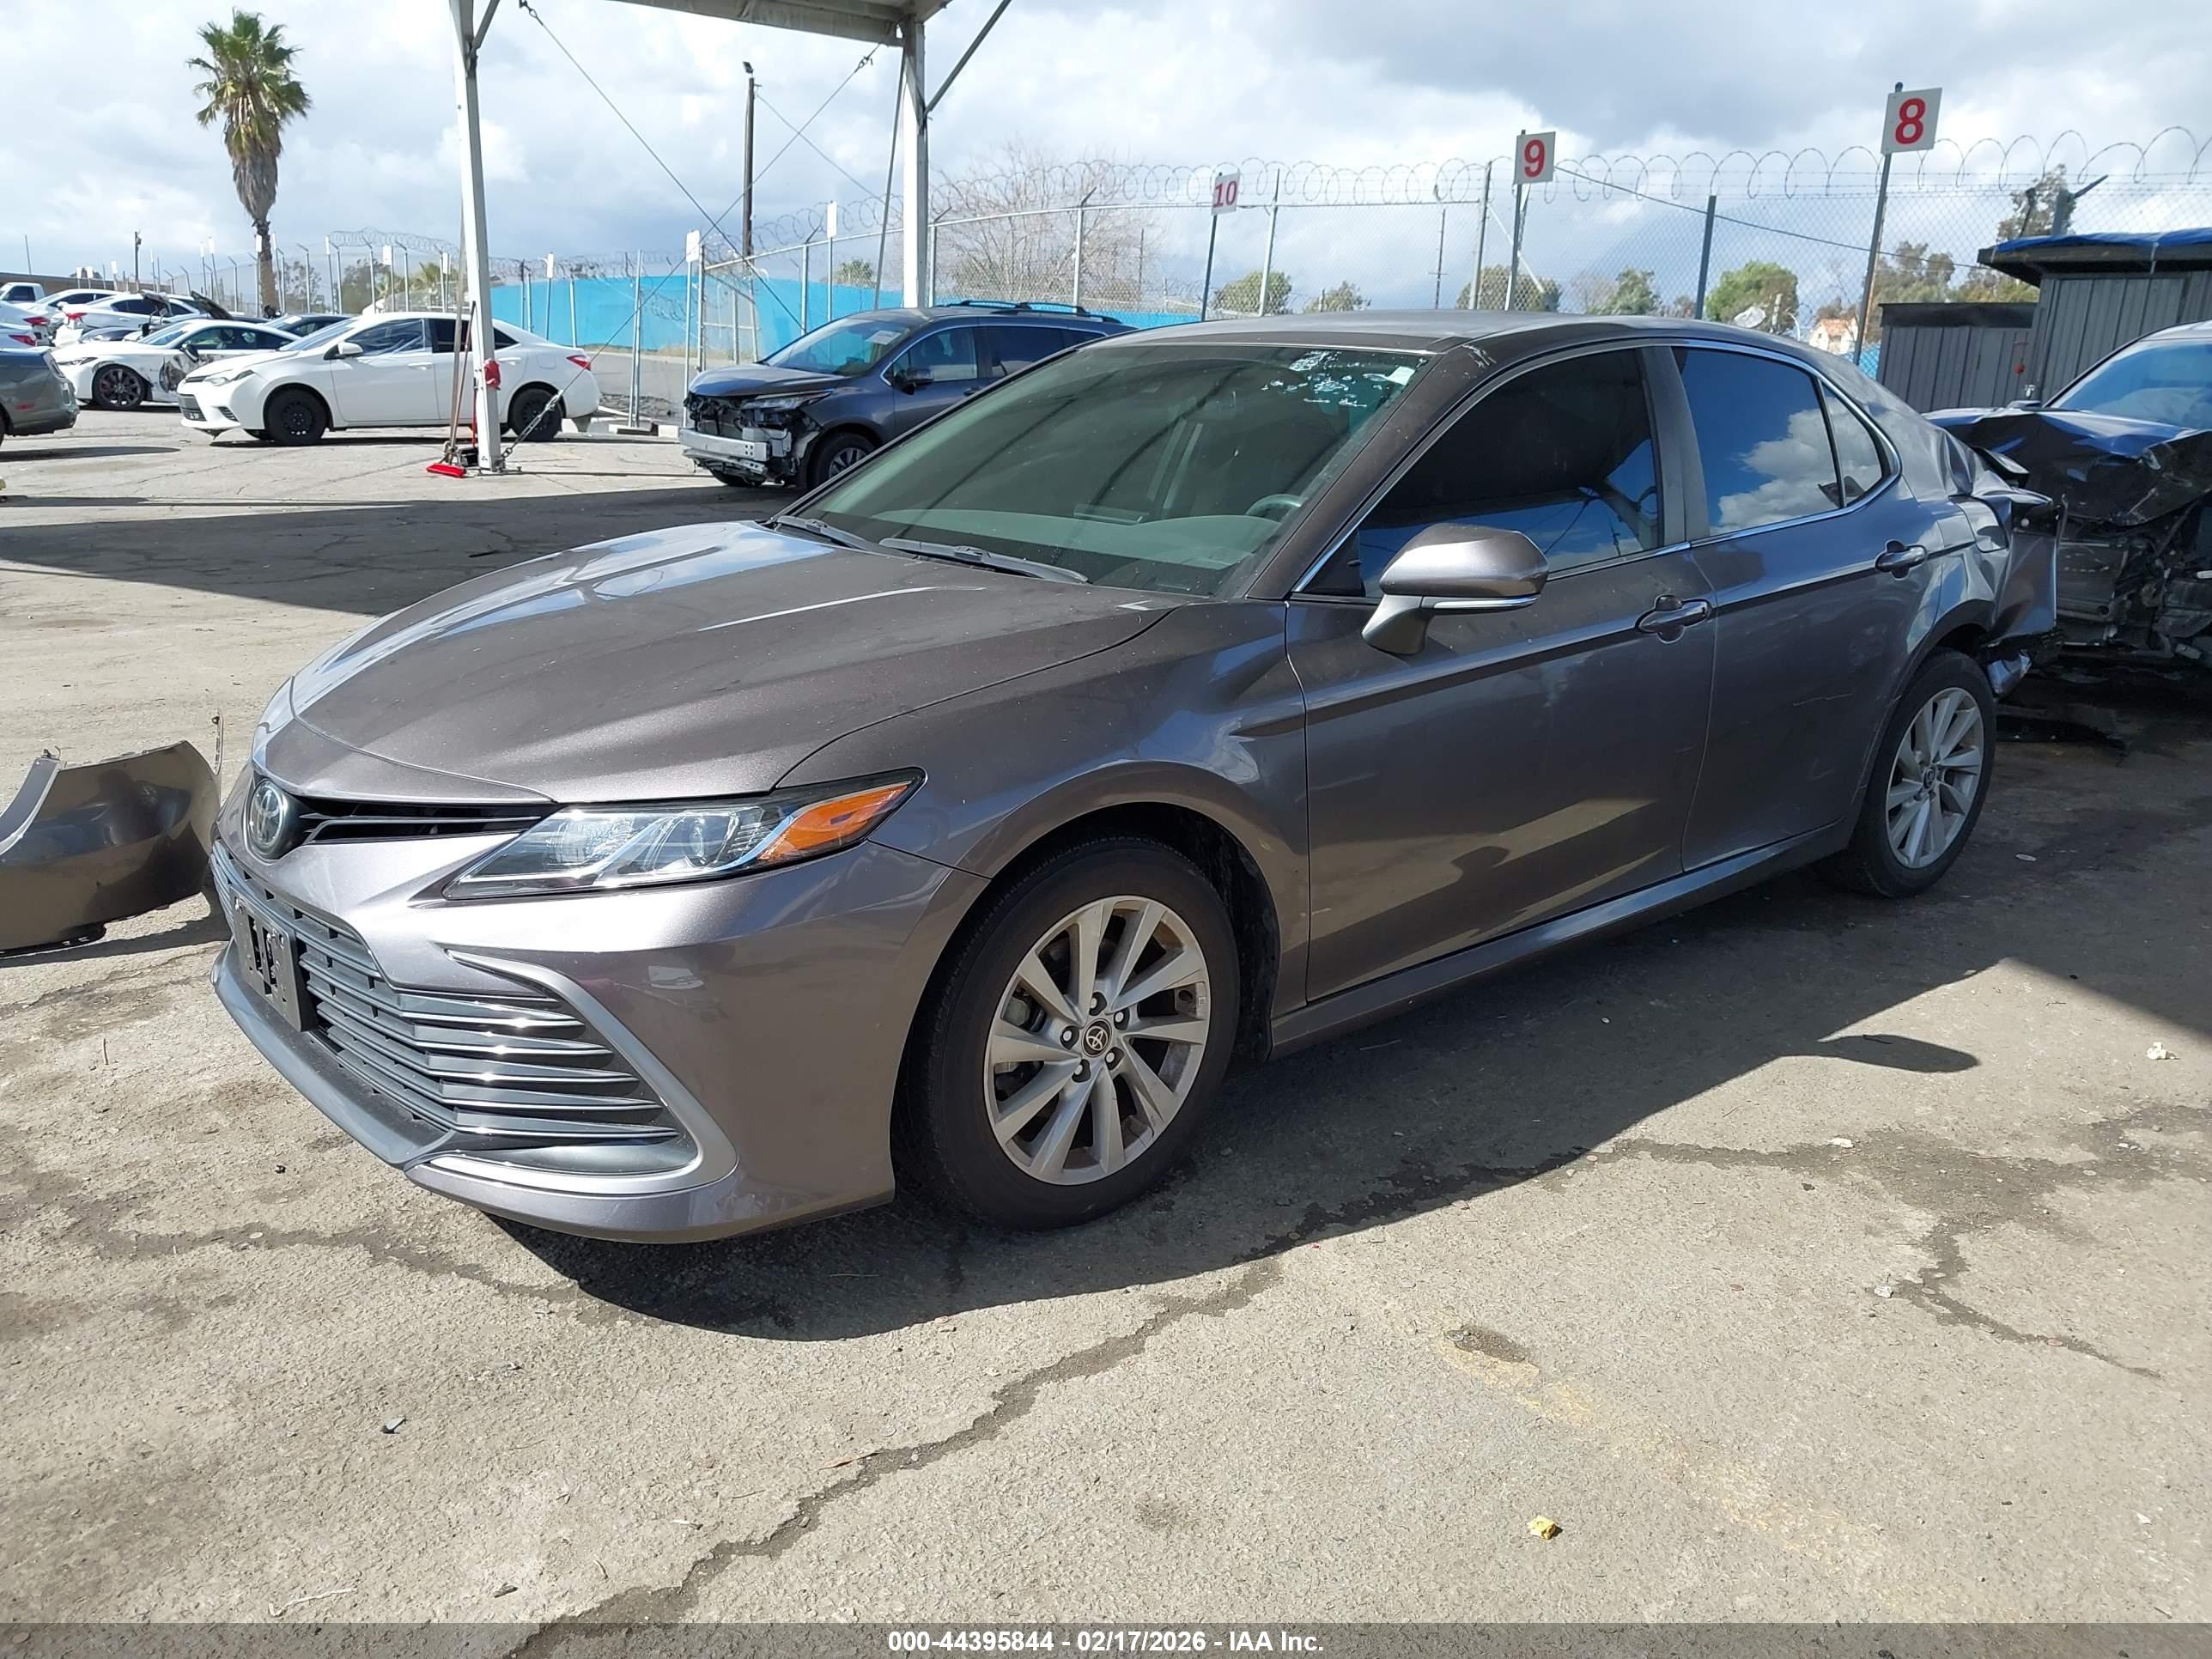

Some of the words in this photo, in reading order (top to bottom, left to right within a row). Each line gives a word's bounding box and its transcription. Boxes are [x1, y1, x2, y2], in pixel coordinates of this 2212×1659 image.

[1895, 99, 1926, 145] 8
[1523, 140, 1546, 178] 9
[1212, 180, 1237, 208] 10
